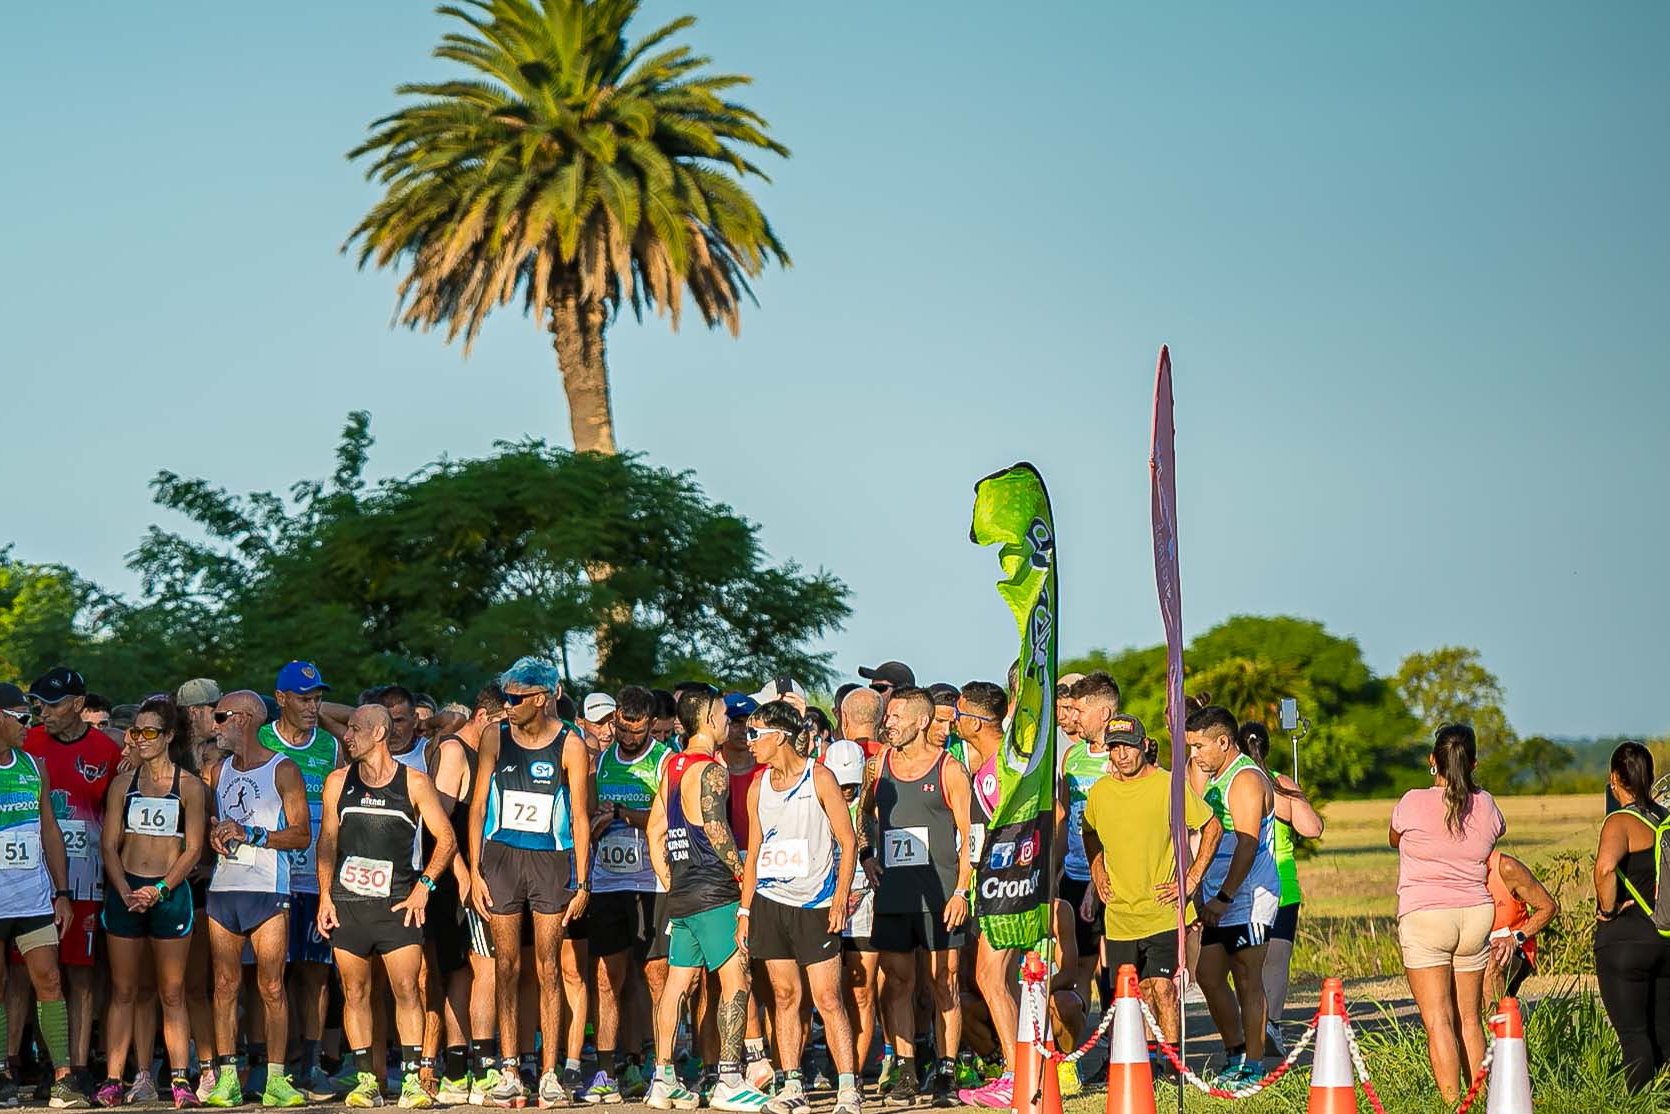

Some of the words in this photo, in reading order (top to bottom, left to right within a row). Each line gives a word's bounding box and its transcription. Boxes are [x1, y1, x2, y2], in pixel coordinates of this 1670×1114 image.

[140, 808, 165, 826] 16
[514, 803, 537, 821] 72
[5, 843, 30, 860] 51
[601, 847, 637, 864] 106
[892, 839, 915, 858] 71
[761, 850, 804, 867] 504
[344, 865, 386, 887] 530
